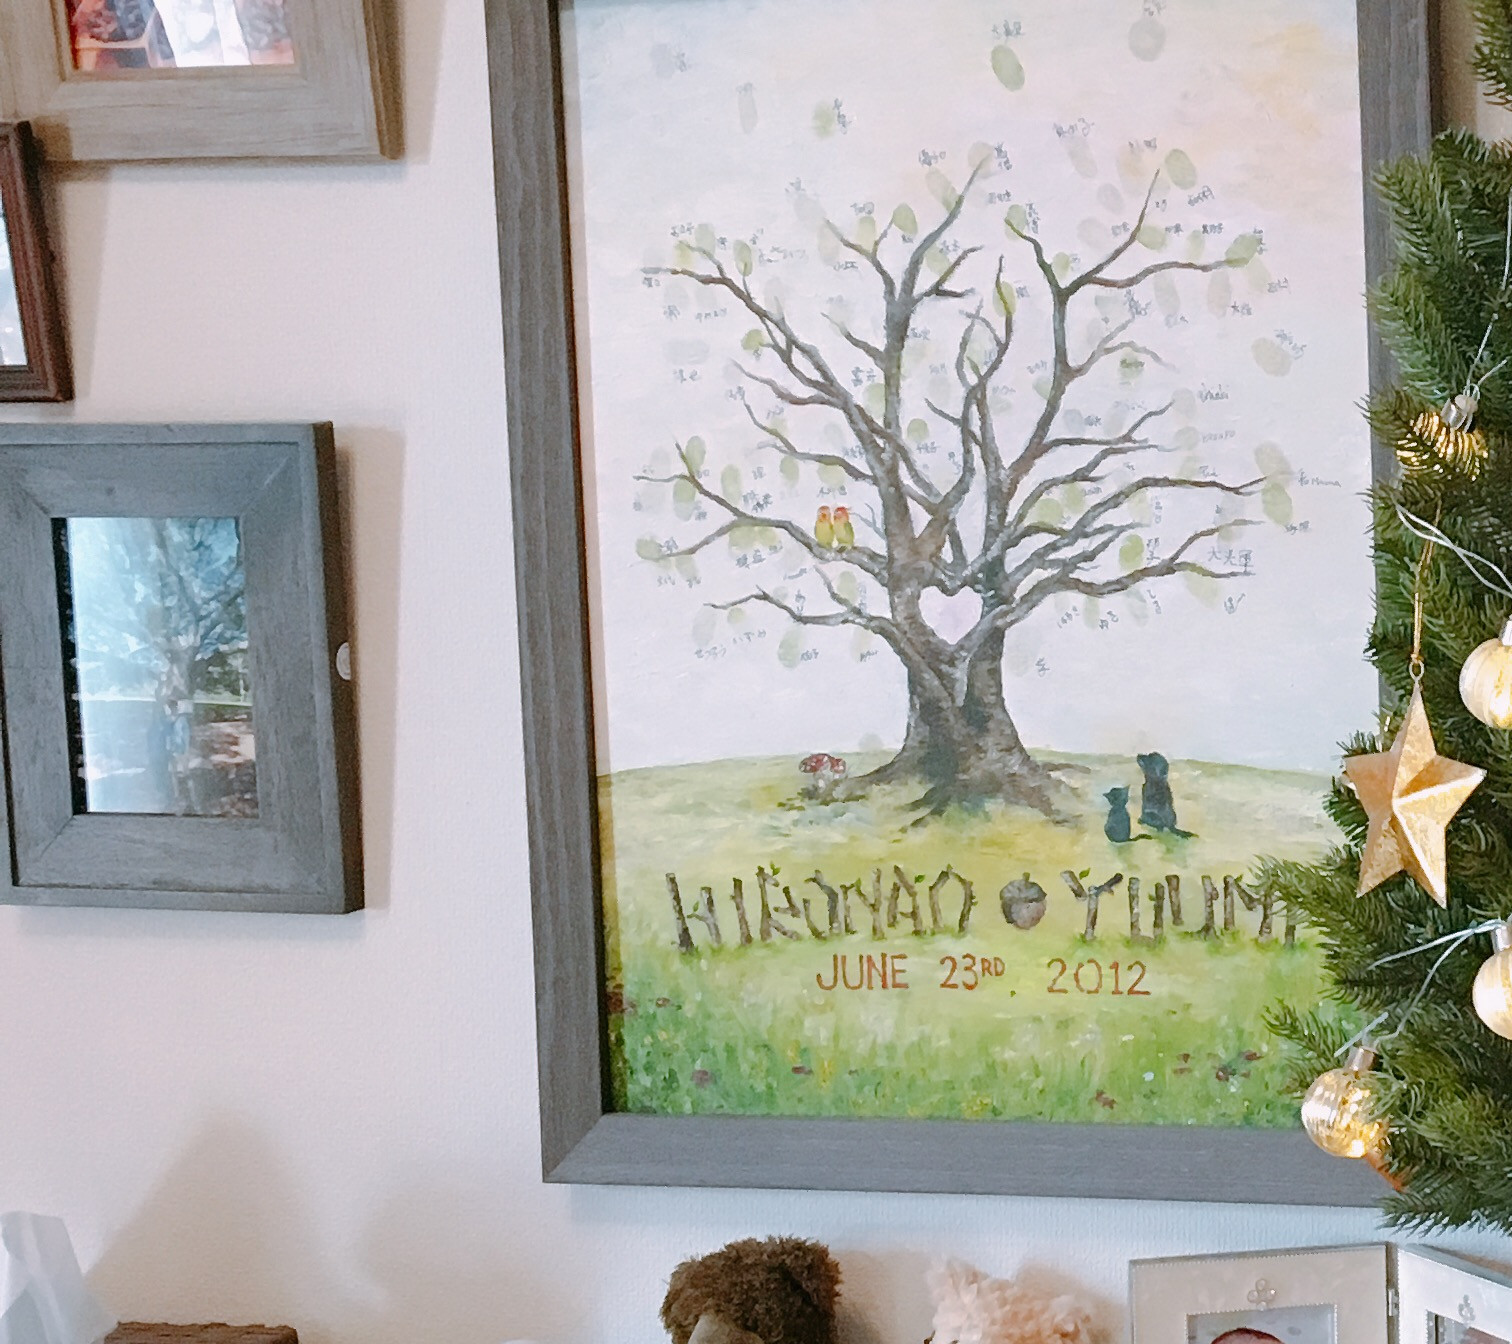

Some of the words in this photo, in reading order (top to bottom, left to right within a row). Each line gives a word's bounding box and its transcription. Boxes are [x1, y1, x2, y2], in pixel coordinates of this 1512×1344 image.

[664, 862, 977, 953] HIRONAO
[817, 953, 909, 990] JUNE
[940, 953, 1006, 990] 23RD
[1047, 958, 1151, 995] 2012
